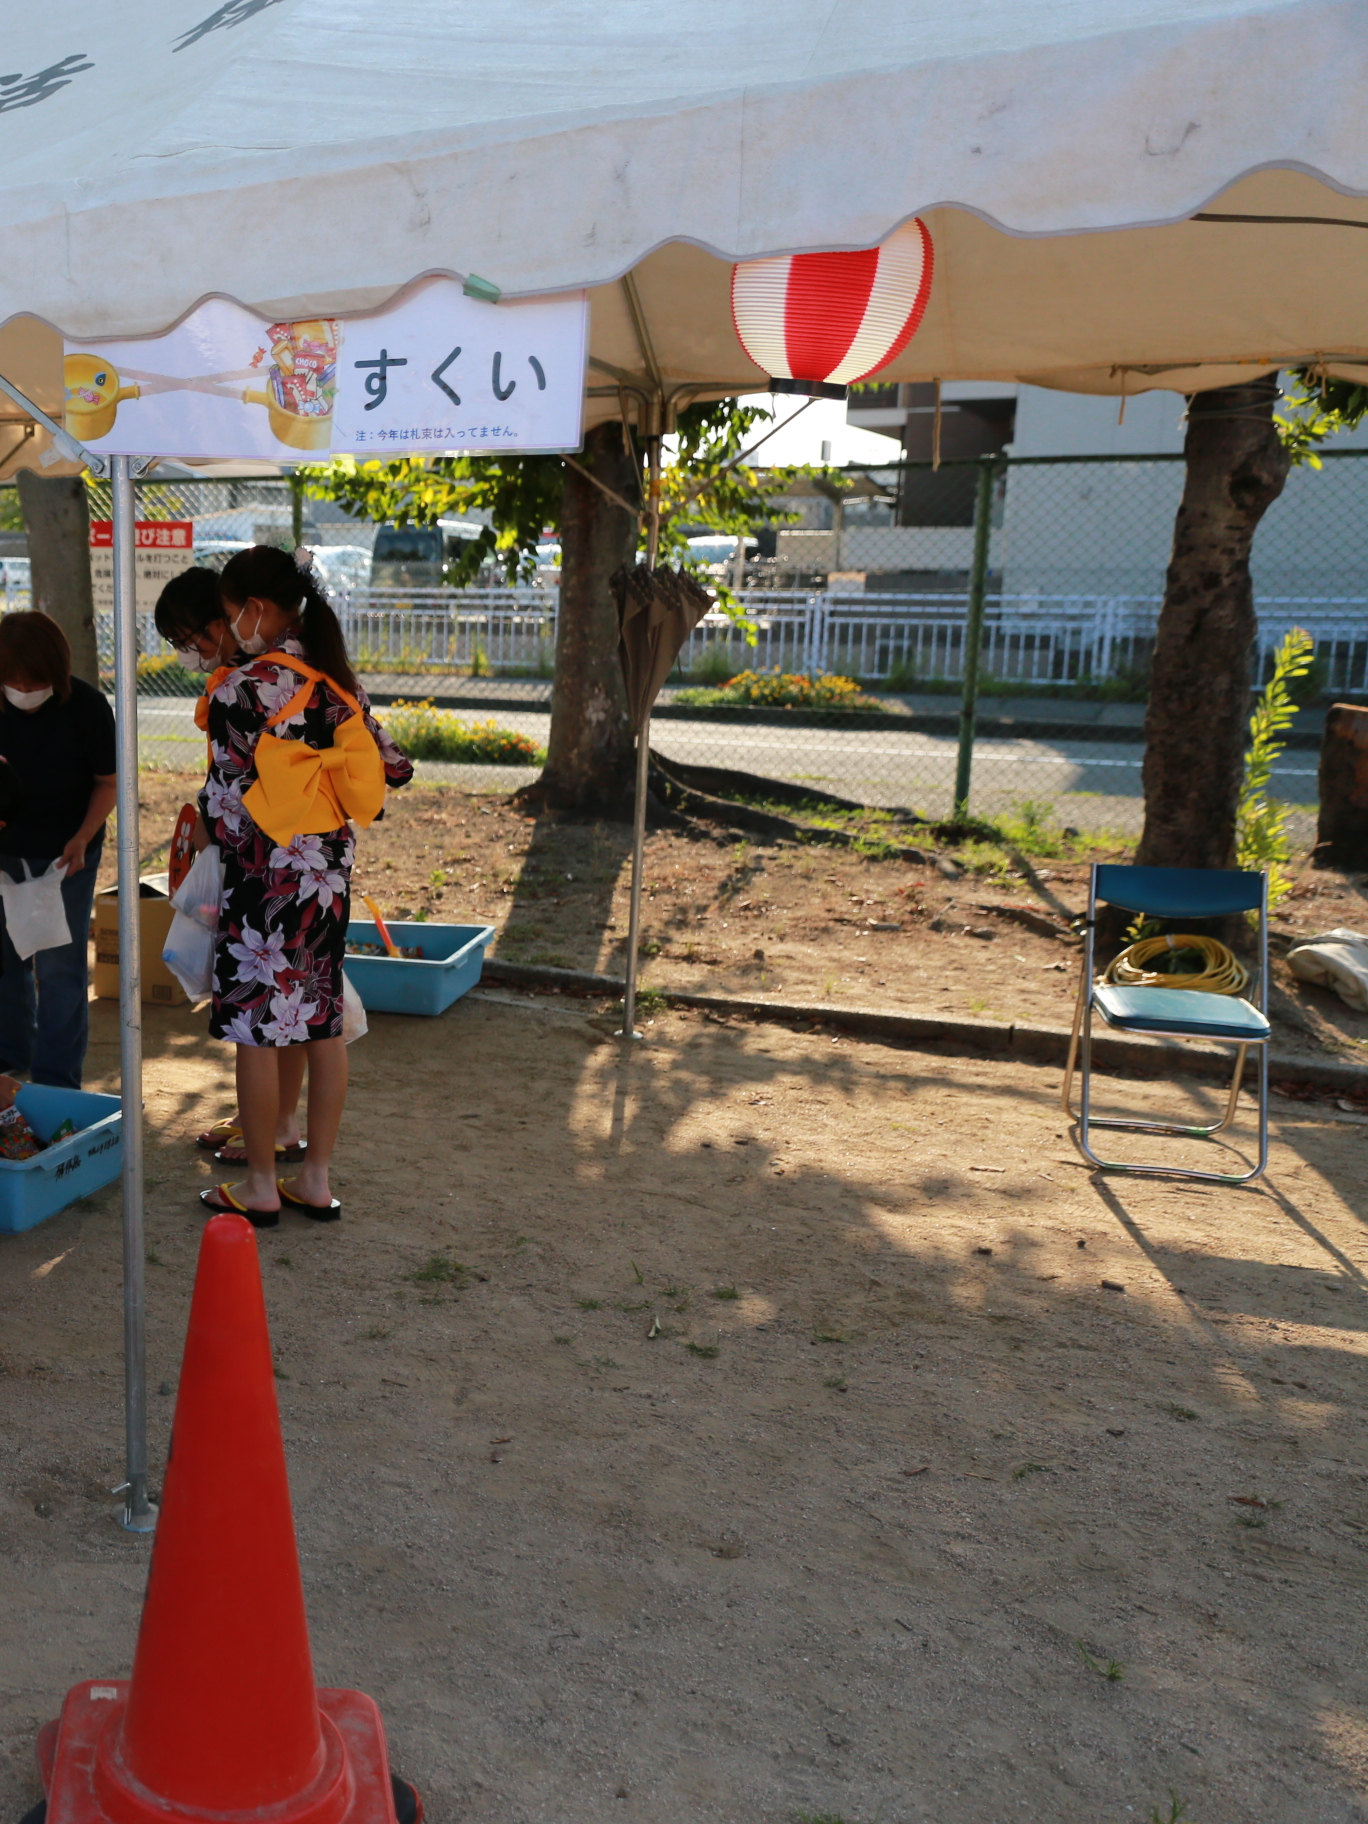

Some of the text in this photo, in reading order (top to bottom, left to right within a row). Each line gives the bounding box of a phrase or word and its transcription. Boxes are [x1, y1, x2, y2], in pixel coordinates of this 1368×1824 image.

[295, 357, 318, 369] CHOCO
[354, 346, 546, 411] すくい
